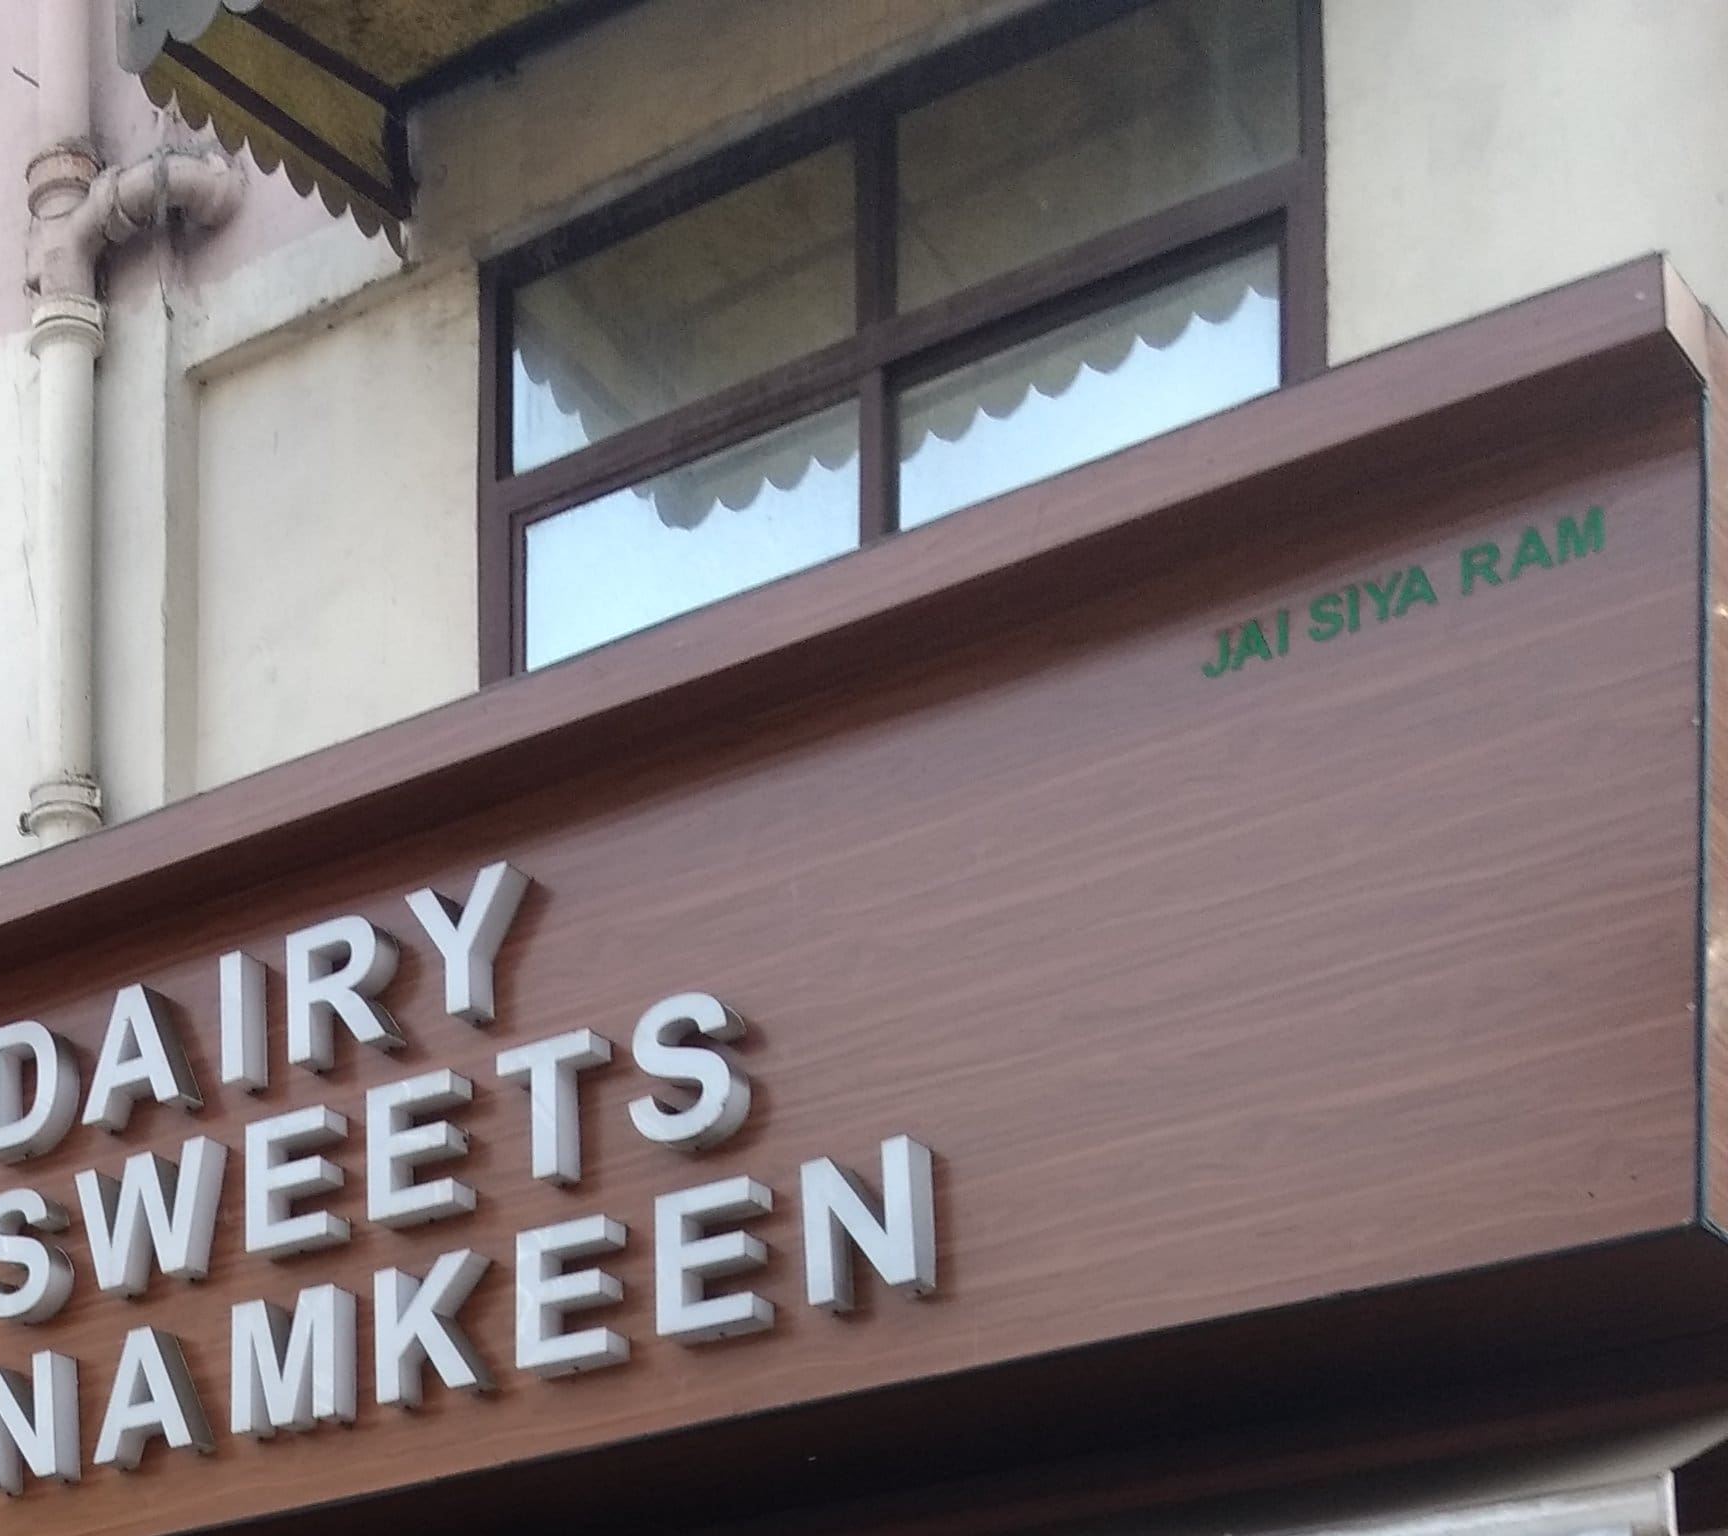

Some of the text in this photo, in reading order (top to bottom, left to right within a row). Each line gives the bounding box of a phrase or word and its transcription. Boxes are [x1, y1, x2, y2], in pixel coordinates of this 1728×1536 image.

[1201, 506, 1606, 679] JAI SIYA RAM
